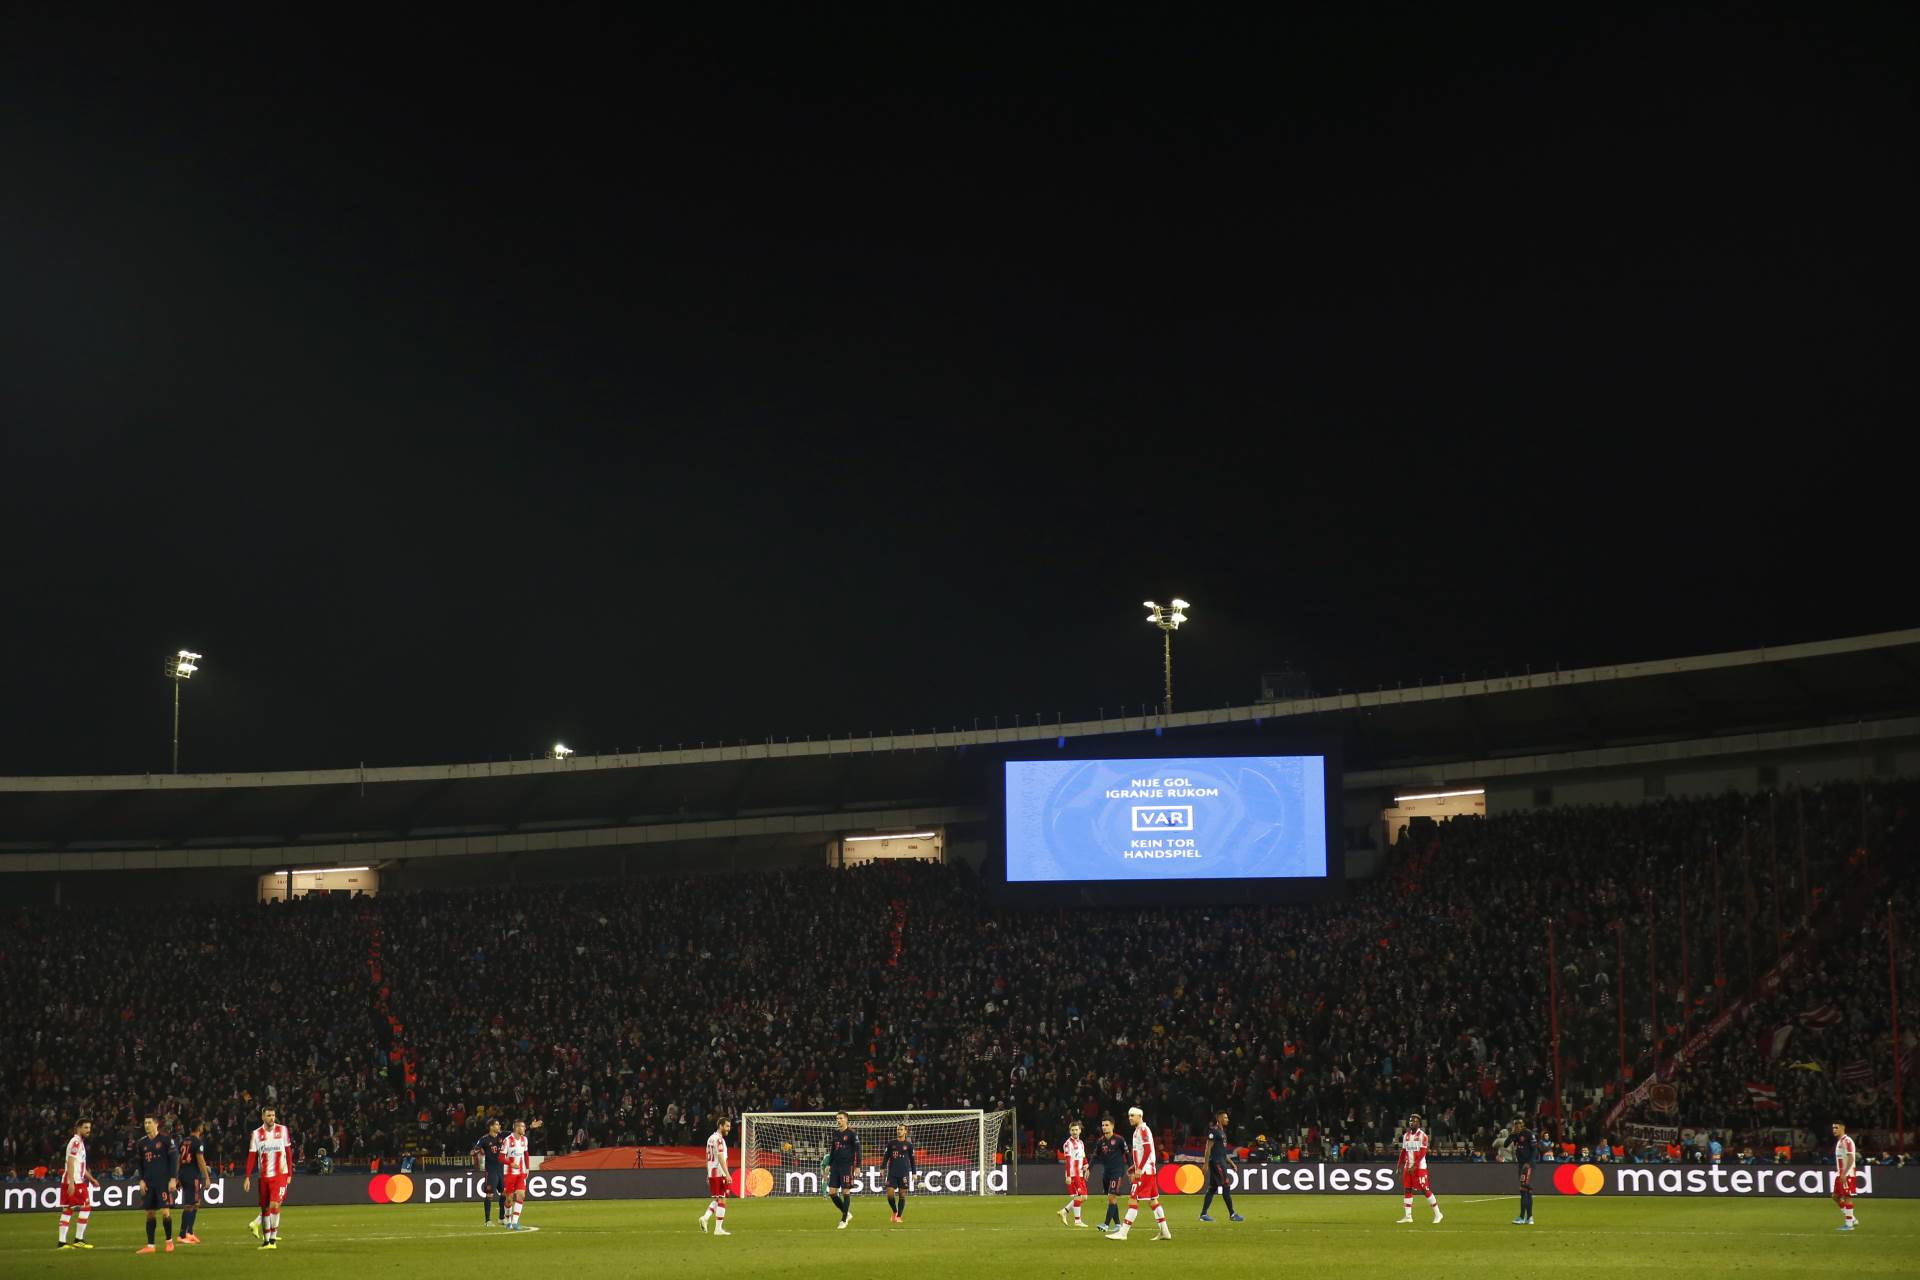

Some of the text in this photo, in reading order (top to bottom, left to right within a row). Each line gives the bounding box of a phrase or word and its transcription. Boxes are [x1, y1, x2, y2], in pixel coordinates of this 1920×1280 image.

[1131, 777, 1193, 788] NIJE GOL
[1106, 786, 1219, 799] IGRANJE RUKOM
[1140, 811, 1184, 826] VAR
[1131, 838, 1195, 849] KEIN TOR
[1124, 849, 1202, 859] HANDSPIEL
[425, 1172, 588, 1203] pricess
